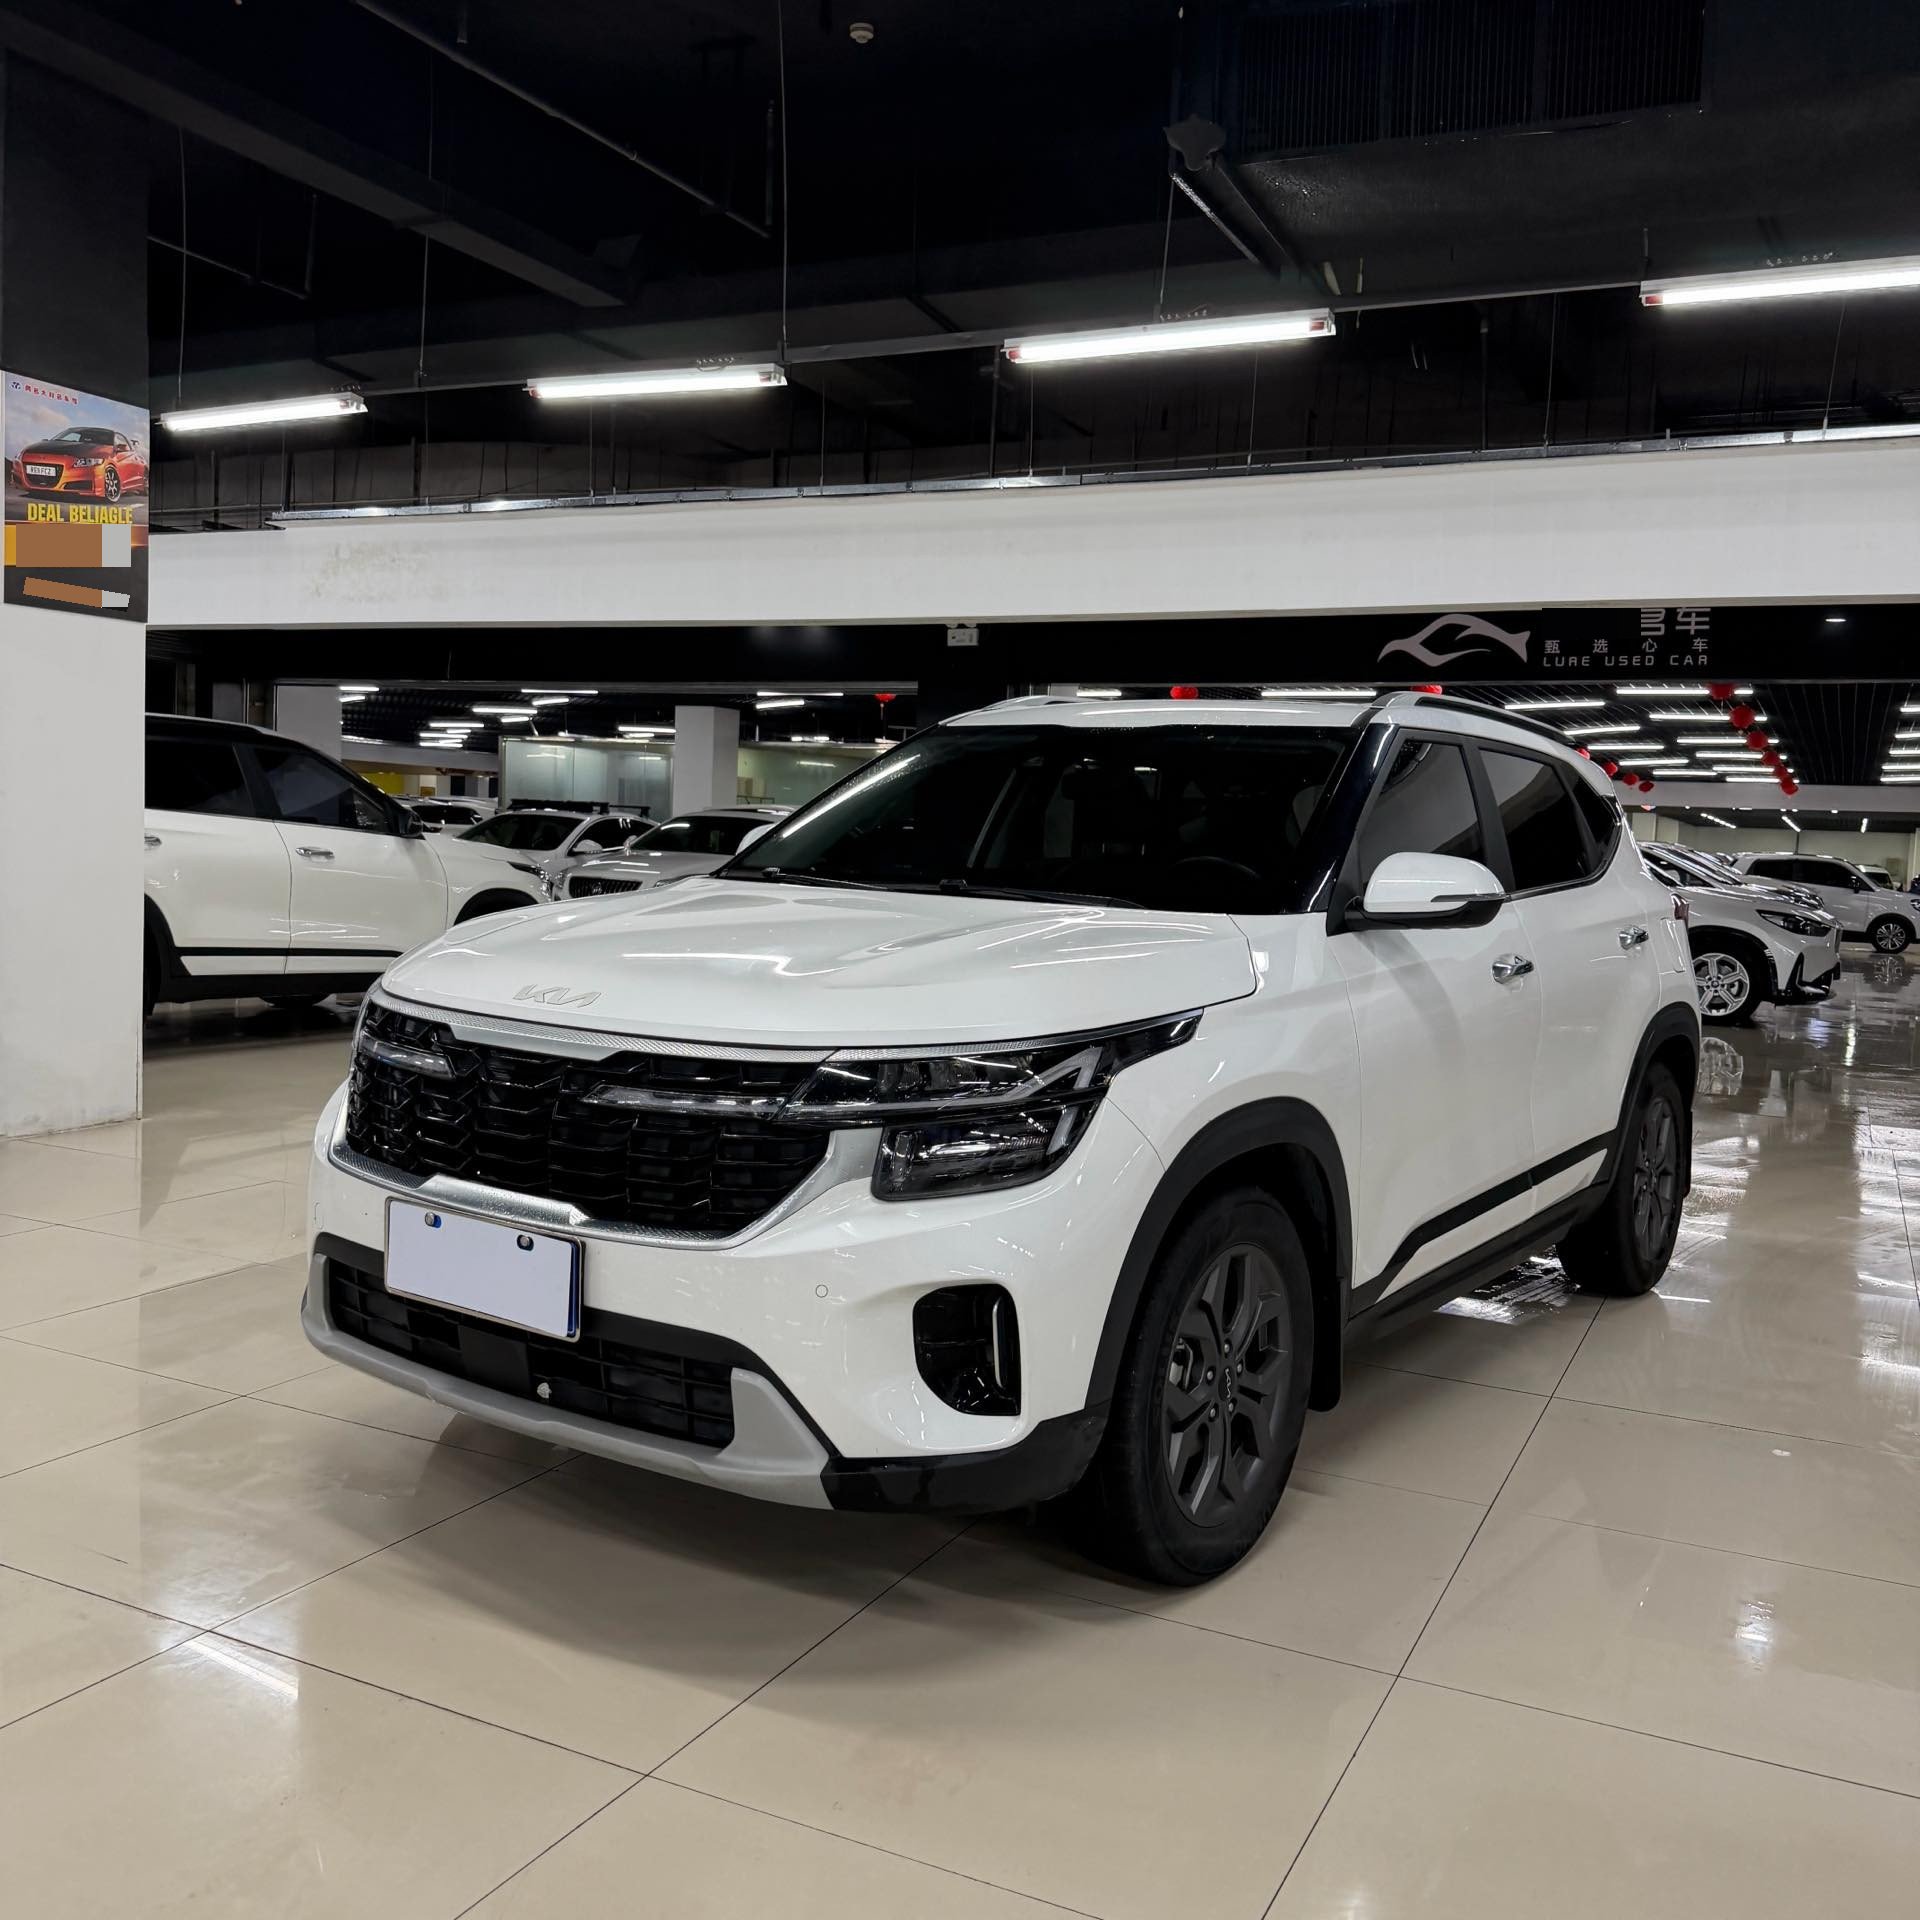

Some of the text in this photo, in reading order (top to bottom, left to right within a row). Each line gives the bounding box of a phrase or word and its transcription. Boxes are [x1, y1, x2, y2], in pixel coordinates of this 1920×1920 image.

[28, 503, 64, 521] DEAL
[1544, 638, 1708, 653] 甄选心车
[1605, 656, 1654, 666] USED
[1669, 655, 1708, 666] CAR
